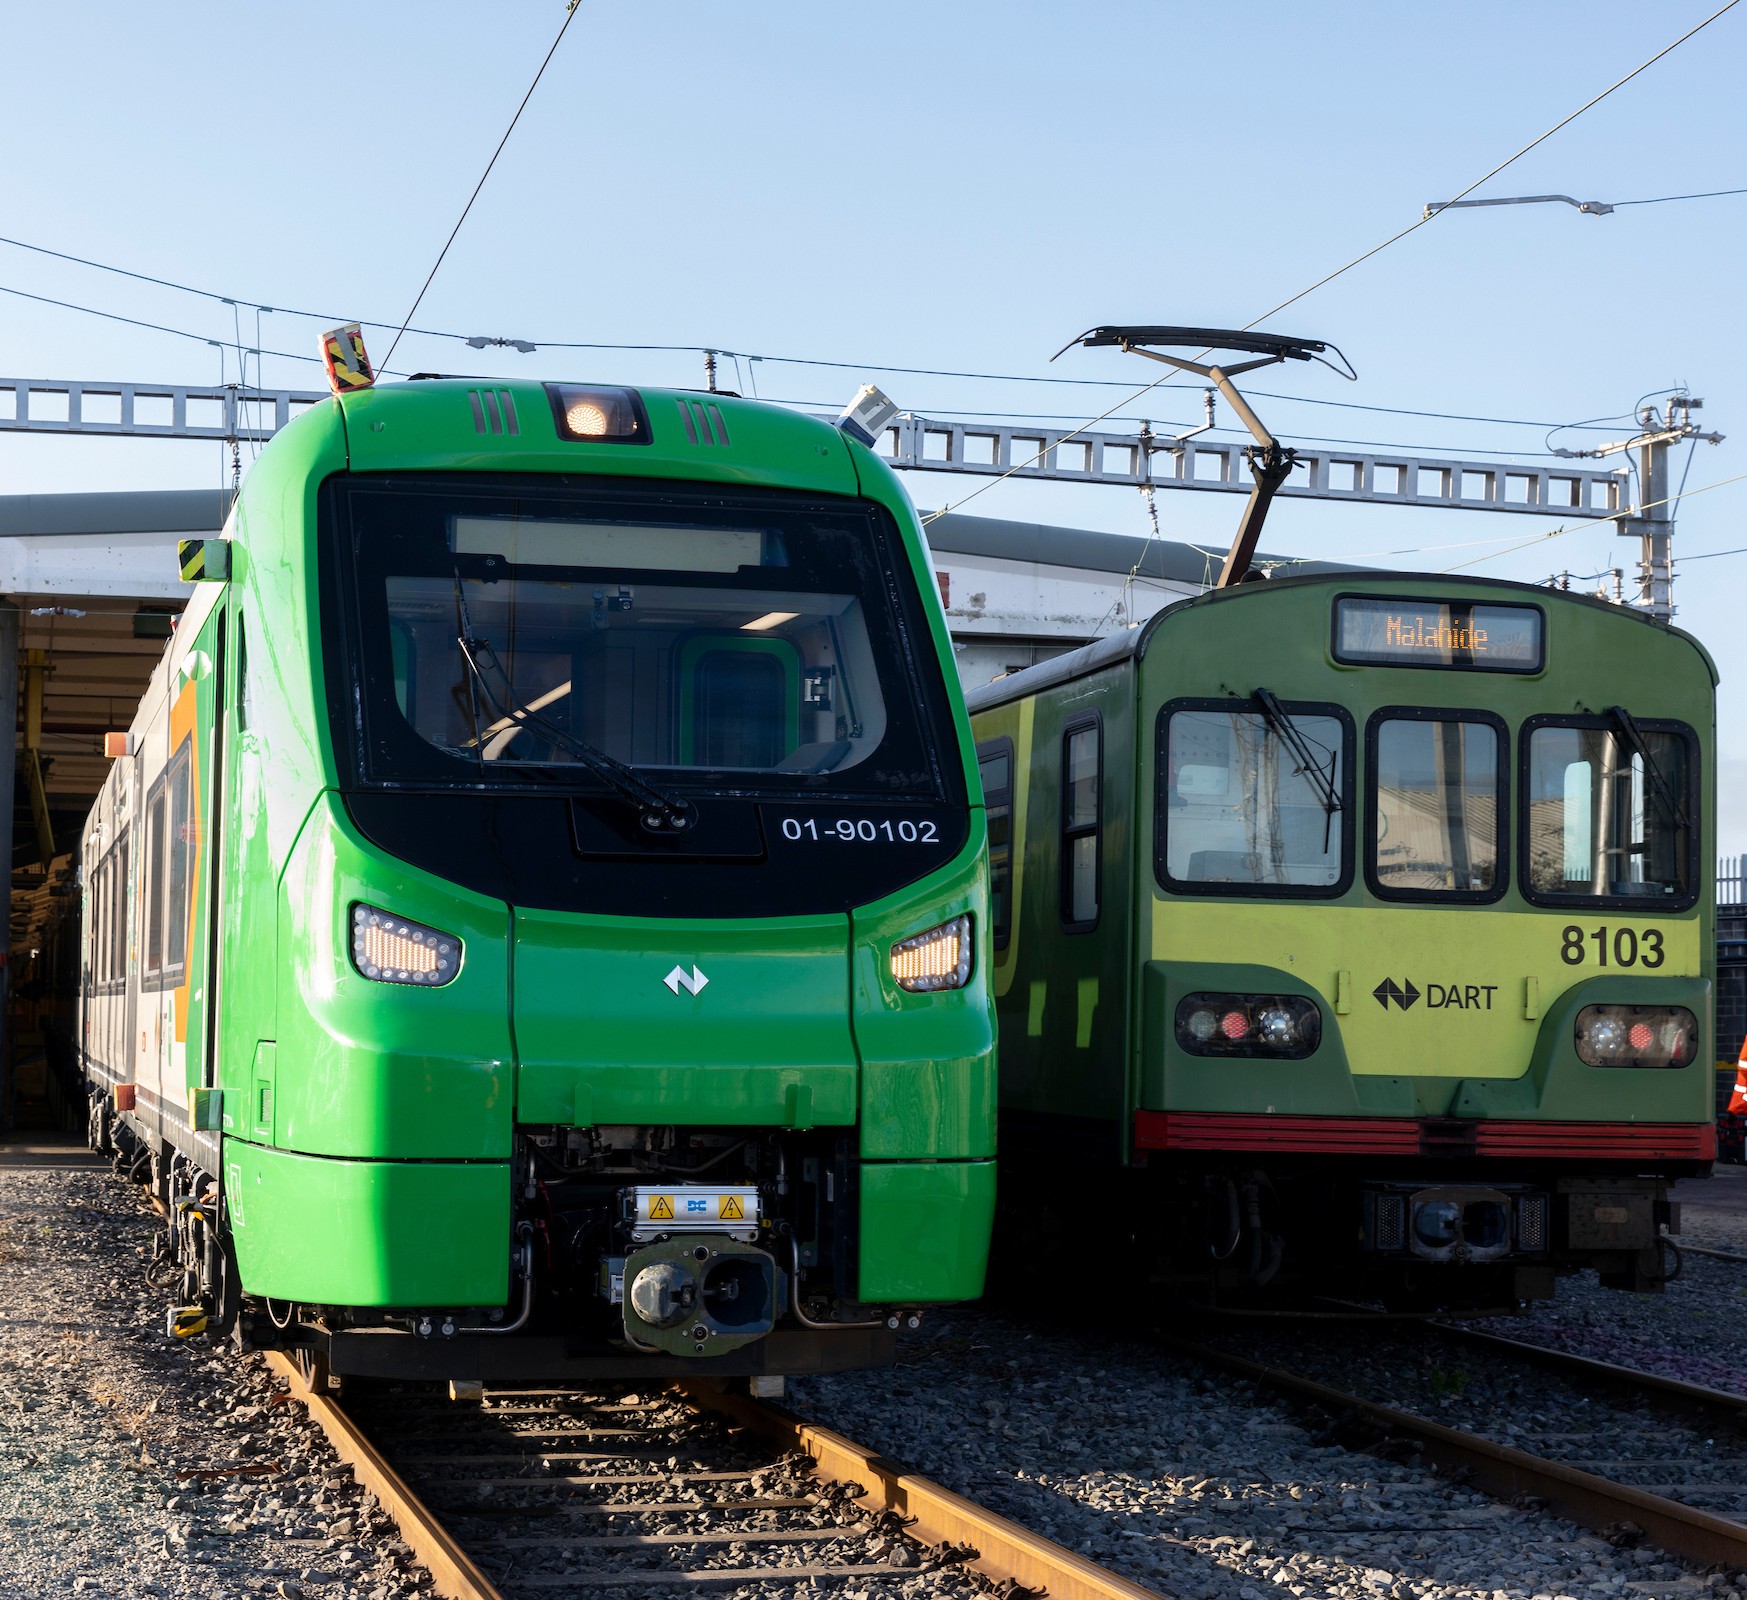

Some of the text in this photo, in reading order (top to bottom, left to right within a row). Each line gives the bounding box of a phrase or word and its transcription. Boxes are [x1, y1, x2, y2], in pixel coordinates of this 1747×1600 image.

[1386, 616, 1488, 650] Malahide
[782, 818, 940, 843] 01-90102
[1560, 925, 1665, 968] 8103
[1427, 983, 1498, 1010] DART
